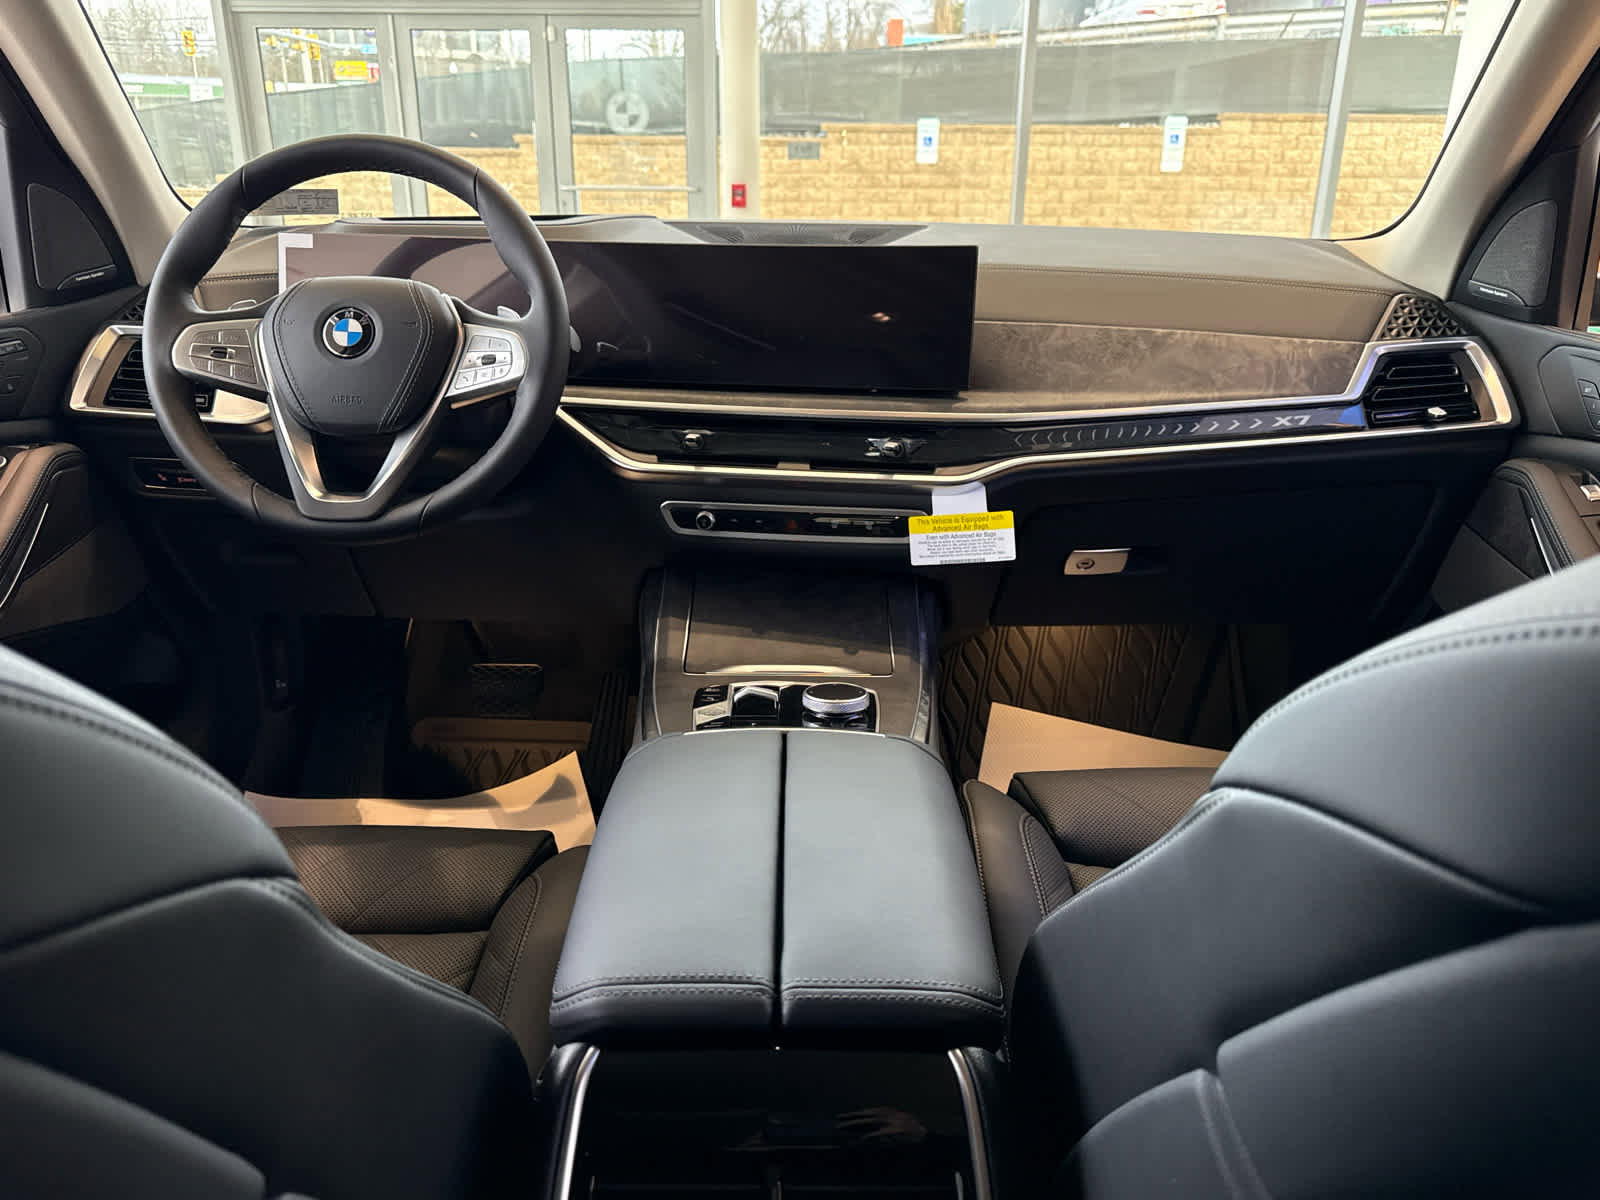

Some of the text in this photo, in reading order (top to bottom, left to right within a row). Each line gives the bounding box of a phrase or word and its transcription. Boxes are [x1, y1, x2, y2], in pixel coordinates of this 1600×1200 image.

[329, 311, 369, 326] BMW
[1271, 415, 1312, 427] X7
[961, 515, 990, 524] Equipped
[932, 524, 962, 532] Advanced
